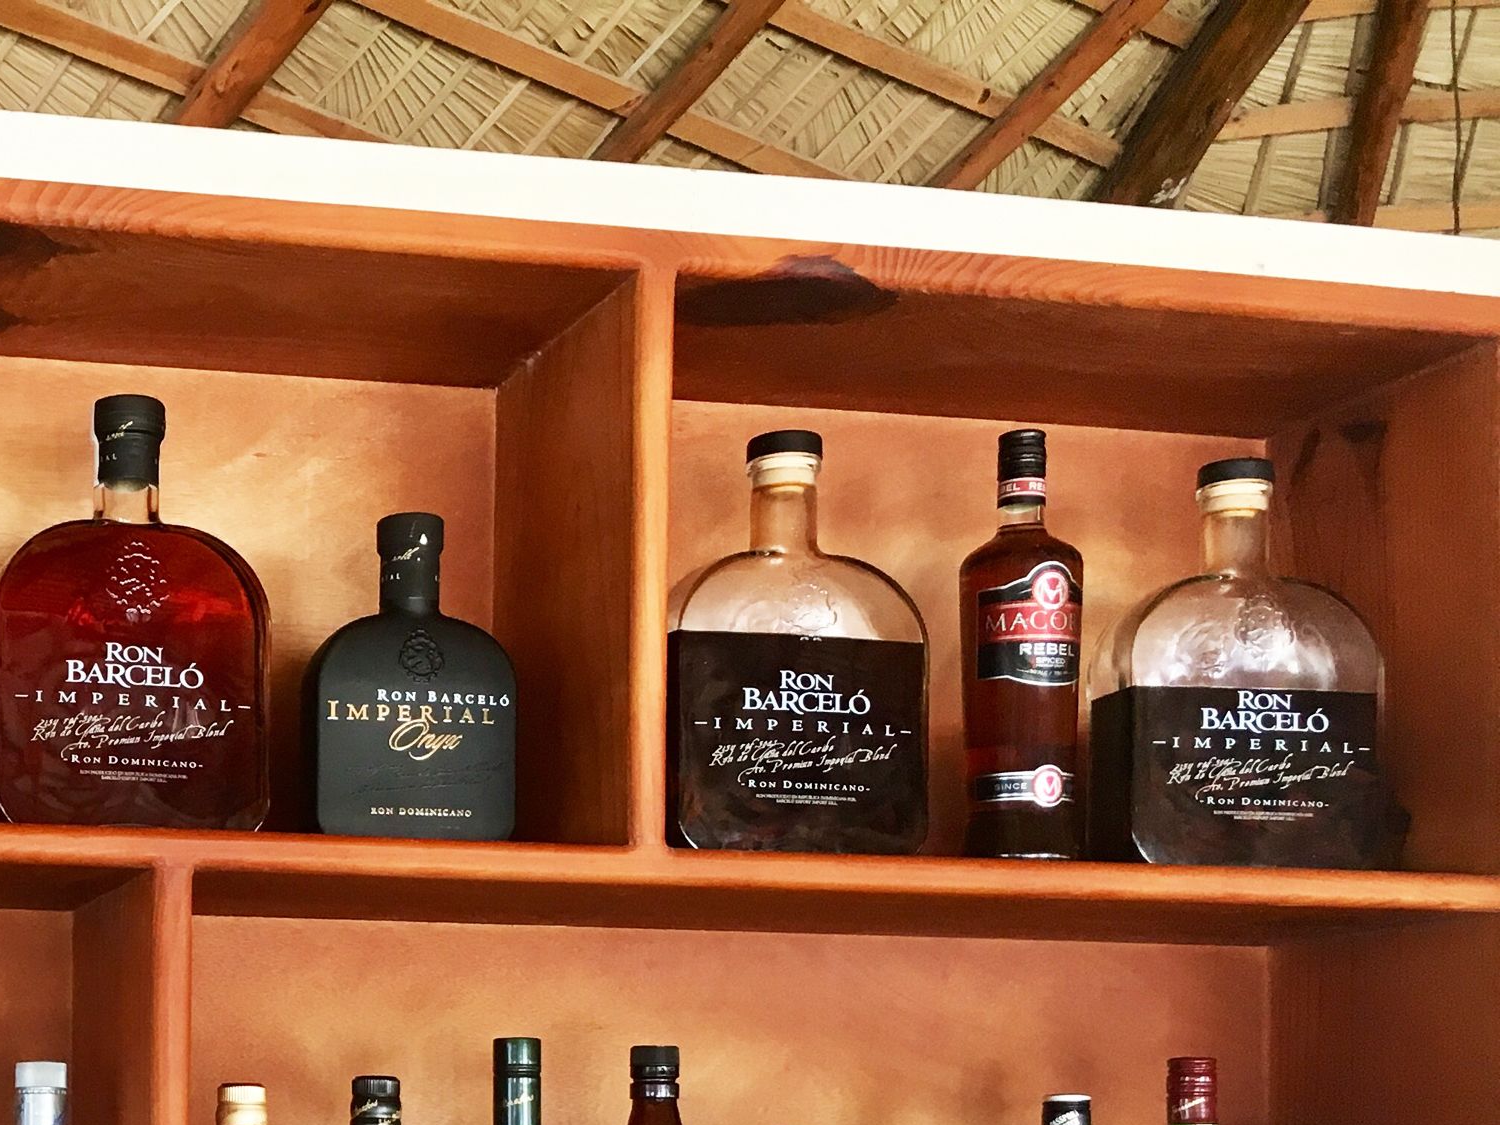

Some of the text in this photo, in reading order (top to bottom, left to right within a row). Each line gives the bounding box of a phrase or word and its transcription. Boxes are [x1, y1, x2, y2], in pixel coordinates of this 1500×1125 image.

[104, 641, 164, 664] RON
[1019, 642, 1075, 657] REBEL
[65, 659, 204, 689] BARCELÓ
[779, 669, 834, 691] RON
[35, 689, 232, 712] IMPERIAL
[376, 688, 510, 707] RON BARCELÓ
[742, 687, 871, 715] BARCELÓ
[1237, 690, 1293, 710] RON
[327, 699, 495, 725] IMPERIAL
[1200, 707, 1329, 734] BARCELÓ
[713, 716, 896, 737] IMPERIAL
[389, 718, 463, 761] Onyx
[1172, 736, 1354, 754] IMPERIAL
[370, 807, 472, 818] RON DOMINICANO
